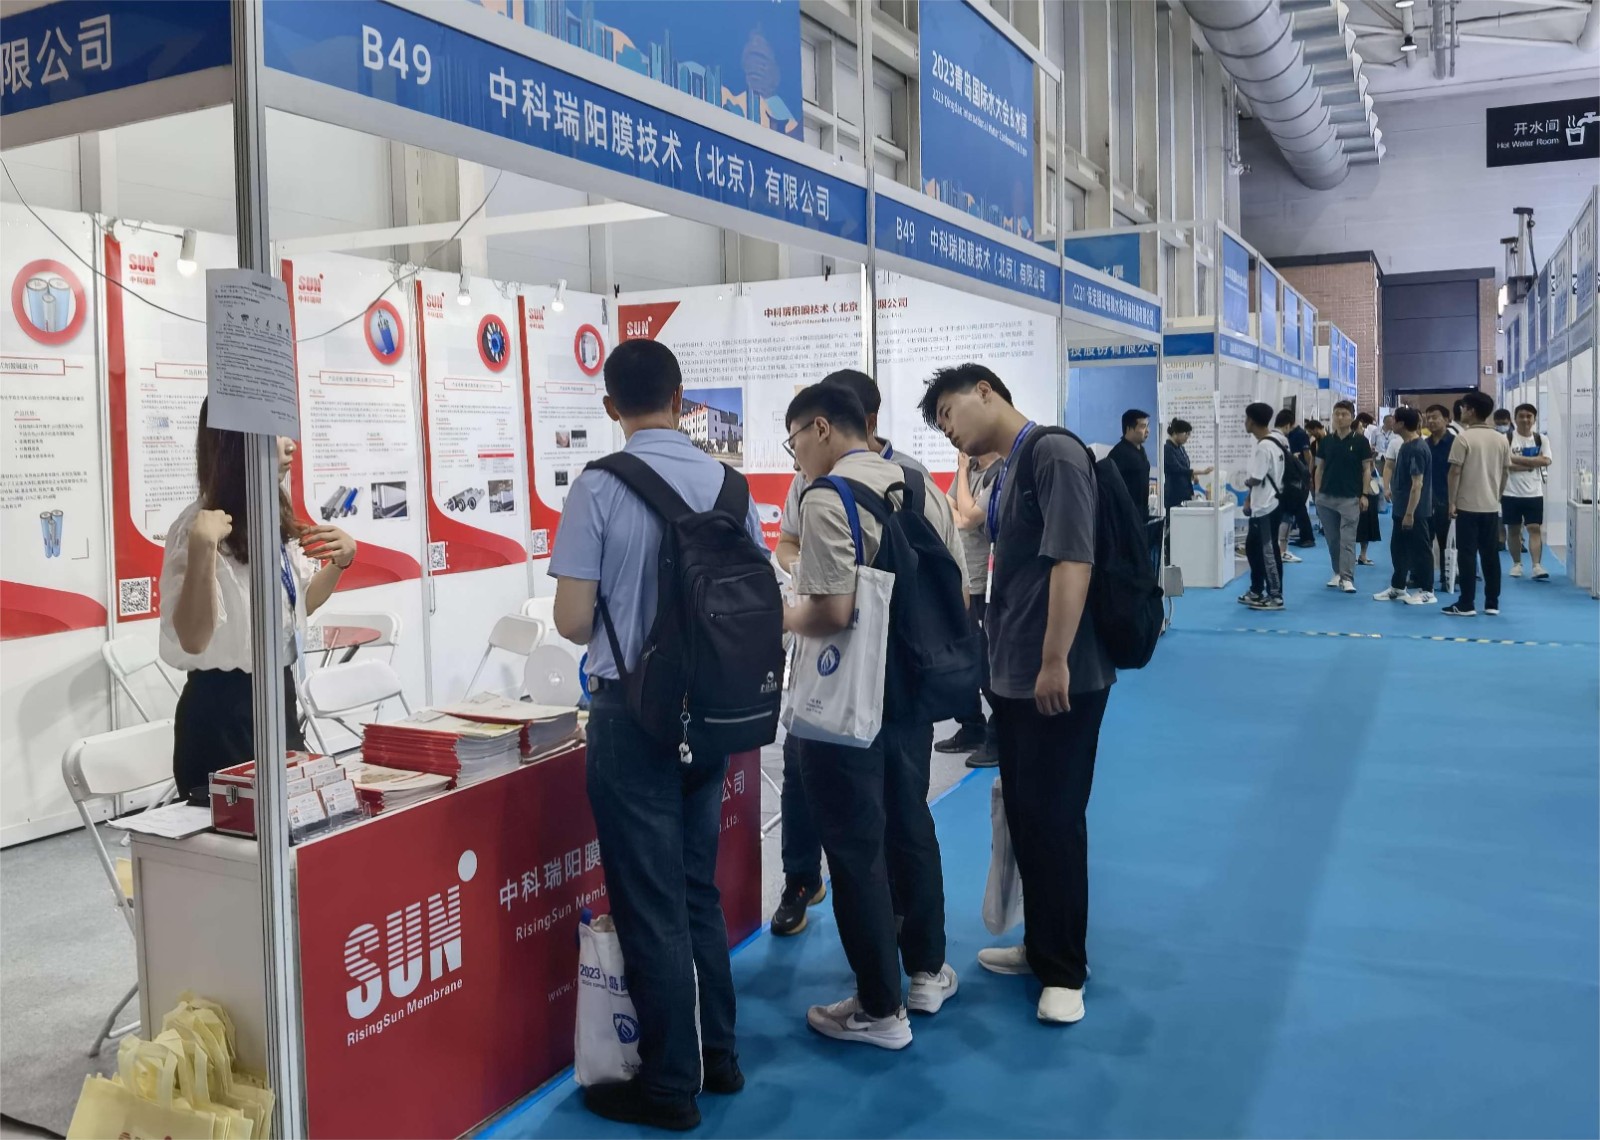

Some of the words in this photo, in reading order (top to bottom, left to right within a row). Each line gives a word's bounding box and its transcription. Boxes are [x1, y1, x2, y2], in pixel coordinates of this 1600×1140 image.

[0, 14, 112, 96] 限公司
[362, 25, 432, 85] B49
[489, 67, 830, 221] 中科瑞阳膜技术（北京）有限公司
[932, 50, 1028, 139] 2023青岛国际水大会&水展
[1512, 140, 1534, 148] Water
[1536, 138, 1560, 146] Room
[1513, 119, 1560, 136] 开水间
[129, 253, 155, 272] SUN
[298, 275, 321, 292] SUN
[896, 216, 915, 244] B49
[930, 226, 1046, 292] 中科瑞阳膜技术（北京）有限公司
[426, 294, 443, 309] SUN
[626, 320, 649, 336] SUN
[499, 838, 601, 912] 中科瑞阳膜
[722, 769, 745, 802] 公司
[515, 904, 572, 943] RisingSun
[575, 884, 607, 911] Memb
[344, 884, 463, 1020] SUN
[347, 1008, 405, 1047] RisingSun
[407, 978, 463, 1018] Membrane
